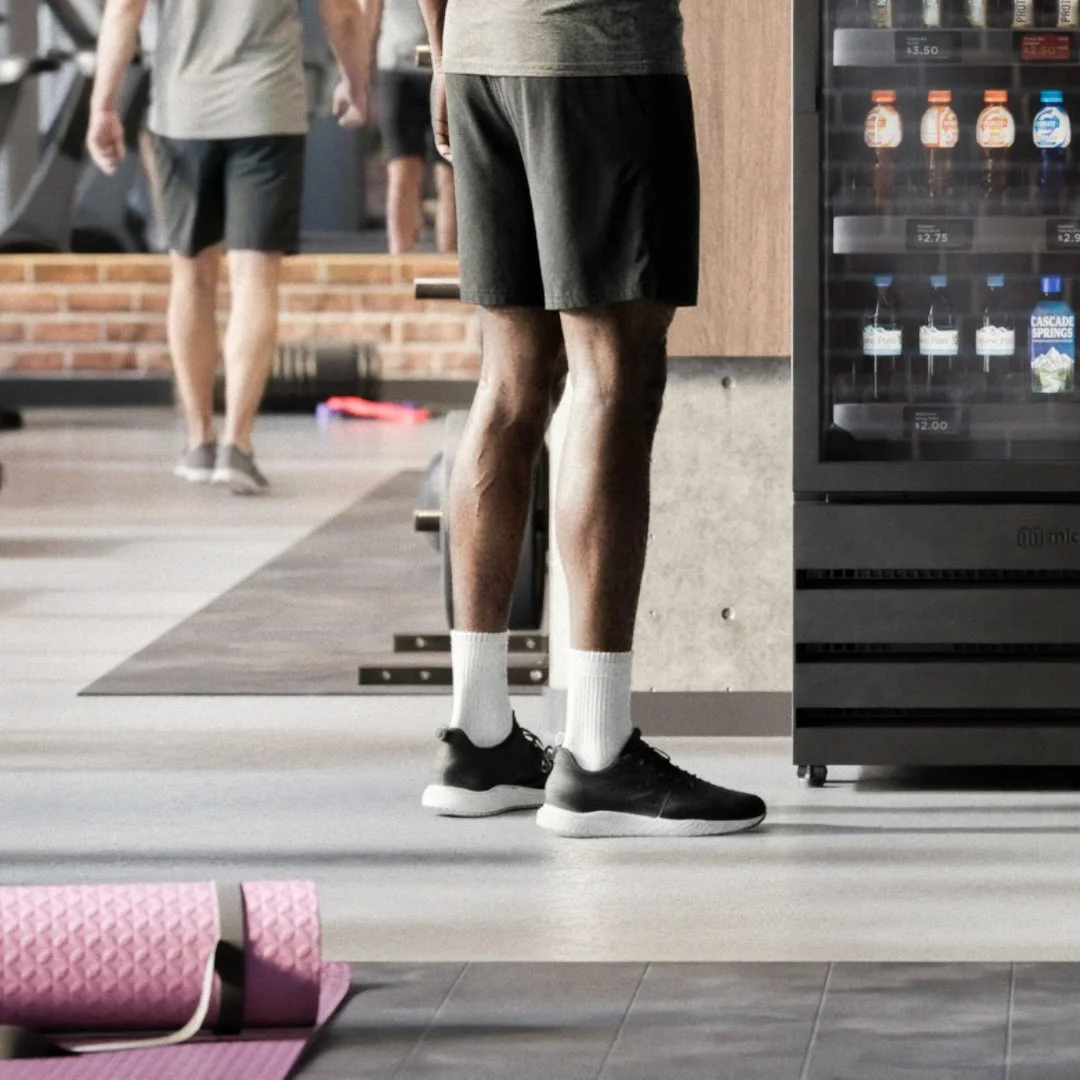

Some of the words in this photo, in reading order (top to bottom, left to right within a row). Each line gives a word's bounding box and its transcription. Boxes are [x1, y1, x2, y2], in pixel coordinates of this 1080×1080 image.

[906, 45, 938, 56] $3.50
[917, 233, 948, 243] $2.75
[1031, 315, 1074, 327] CASCADE
[1032, 327, 1073, 339] SPRINGS
[914, 421, 948, 431] $2.00
